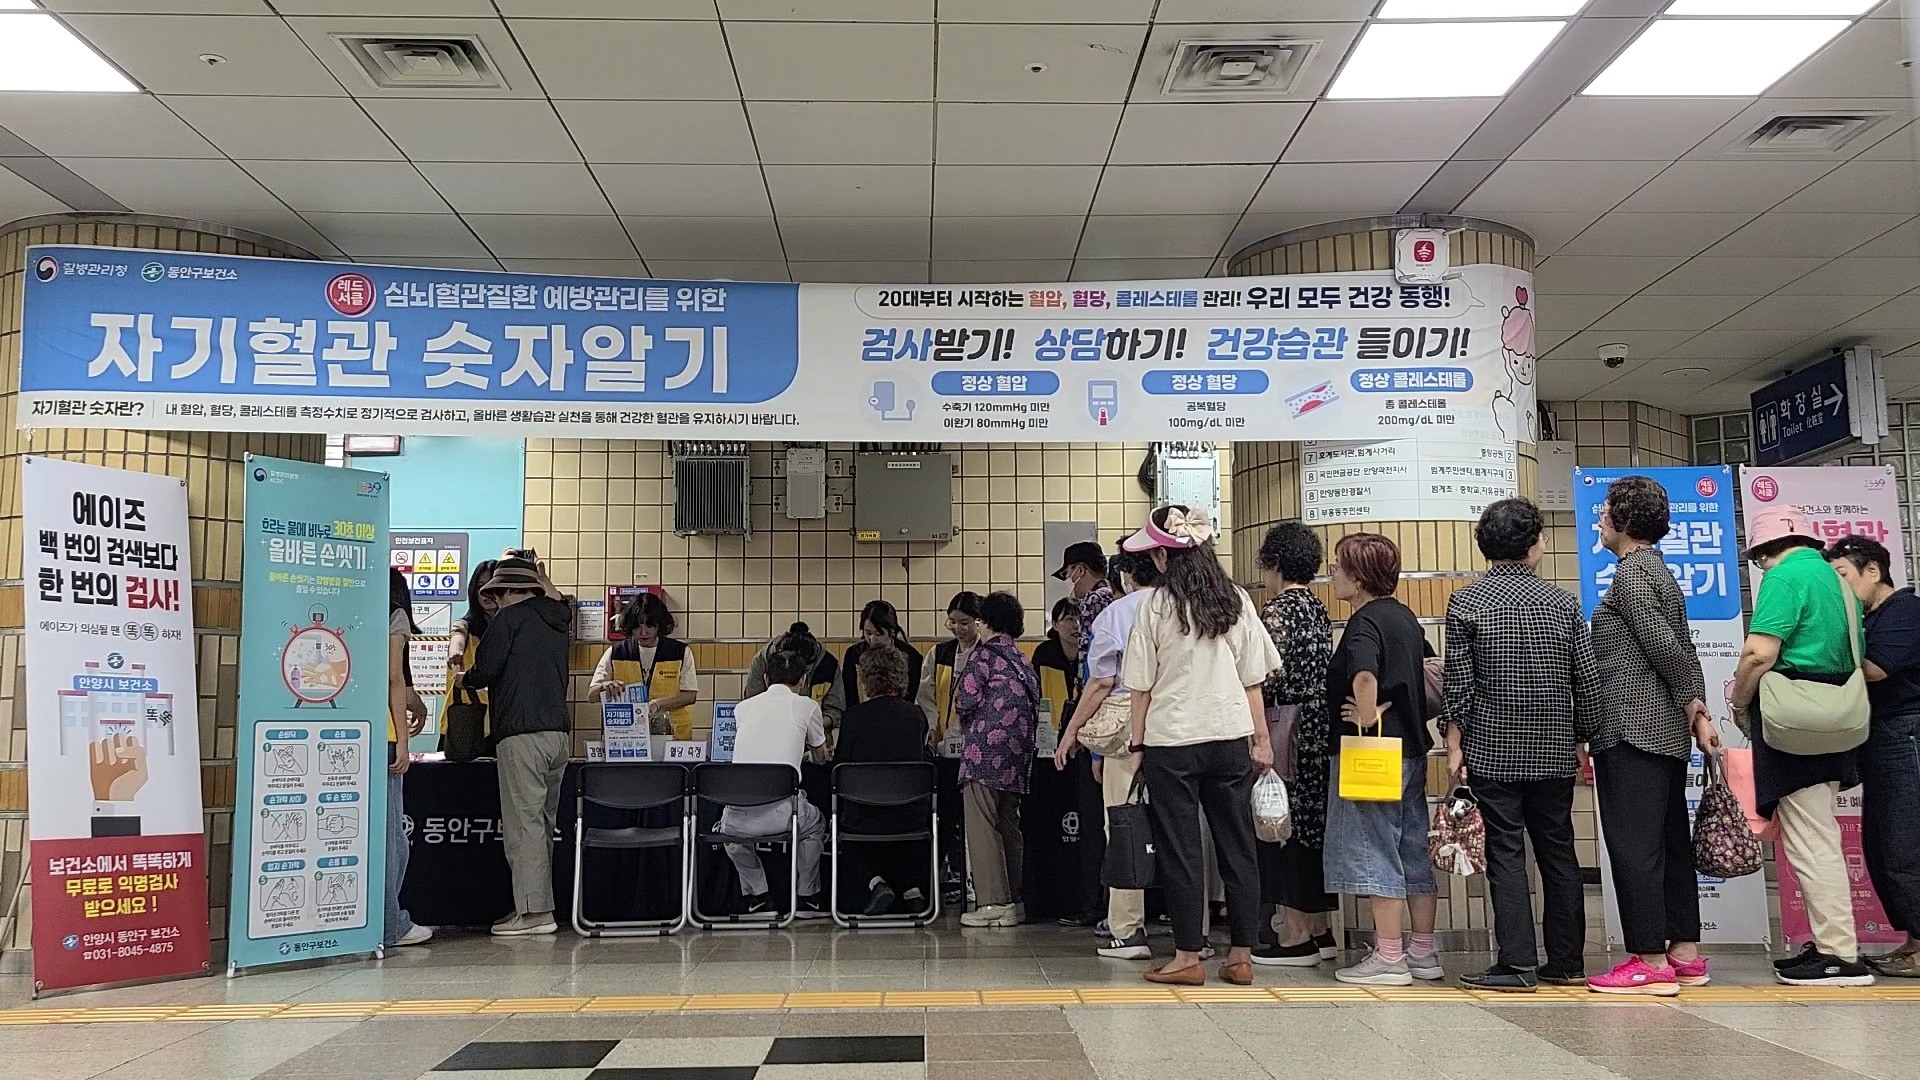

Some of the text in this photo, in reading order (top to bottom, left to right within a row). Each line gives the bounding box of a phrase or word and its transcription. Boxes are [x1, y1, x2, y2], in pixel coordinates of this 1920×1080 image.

[63, 262, 238, 282] 질병관리청 동안구보건소
[337, 279, 364, 292] 레드
[337, 292, 364, 306] 서클
[384, 281, 726, 312] 심뇌혈관질환 예방관리를 위한
[878, 285, 1450, 310] 20대부터 시작하는 혈압, 혈당, 콜레스테롤 관리! 우리 모두 건강 동행!
[88, 313, 728, 393] 자기혈관 숫자알기
[861, 327, 1471, 361] 검사받기! 상담하기! 건강습관 들이기!
[961, 374, 1028, 392] 정상 혈압
[1172, 374, 1238, 391] 정상 혈당
[1358, 373, 1467, 389] 정상 콜레스테롤
[32, 401, 144, 416] 자기혈관 숫자란?
[942, 402, 1050, 414] 수축기 120mmHg 미만
[1186, 401, 1226, 412] 공복혈당
[1398, 399, 1447, 410] 콜레스테롤
[1780, 385, 1823, 420] 화장실
[165, 403, 799, 426] 내 혈압, 혈당, 콜레스테롤 측정수치로 정기적으로 검사하고, 올바른 생활습관 실천을 통해 건강한 혈관을 유지하시기 바랍니다.
[943, 417, 1048, 430] 이완기 80mmHg 미만
[1168, 416, 1245, 430] 100mg/dL 미만
[1378, 415, 1455, 427] 200mg/dL 미만
[1782, 422, 1803, 438] Toilet
[1756, 481, 1772, 489] 레드
[1757, 489, 1773, 497] 서클
[73, 491, 146, 531] 에이즈
[1670, 502, 1719, 513] 관리를 위한
[1834, 505, 1869, 515] 함께하는
[262, 518, 375, 540] 흐르는 물에 비누로 30초 이상
[39, 530, 178, 571] 백 번의 검색보다
[269, 538, 367, 570] 올바른 손씻기
[38, 567, 180, 611] 한 번의 검사!
[40, 620, 78, 634] 에이즈가
[81, 623, 108, 636] 의심될
[110, 625, 120, 636] 땐
[162, 629, 182, 641] 하자!
[79, 677, 153, 691] 안양시 보건소
[49, 851, 192, 876] 보건소에서 똑똑하게
[65, 873, 179, 897] 무료로 익명검사
[84, 897, 146, 918] 받으세요
[83, 927, 180, 946] 안양시 동안구 보건소
[93, 942, 173, 960] 031-8045-4875
[294, 940, 339, 952] 동안구보건소
